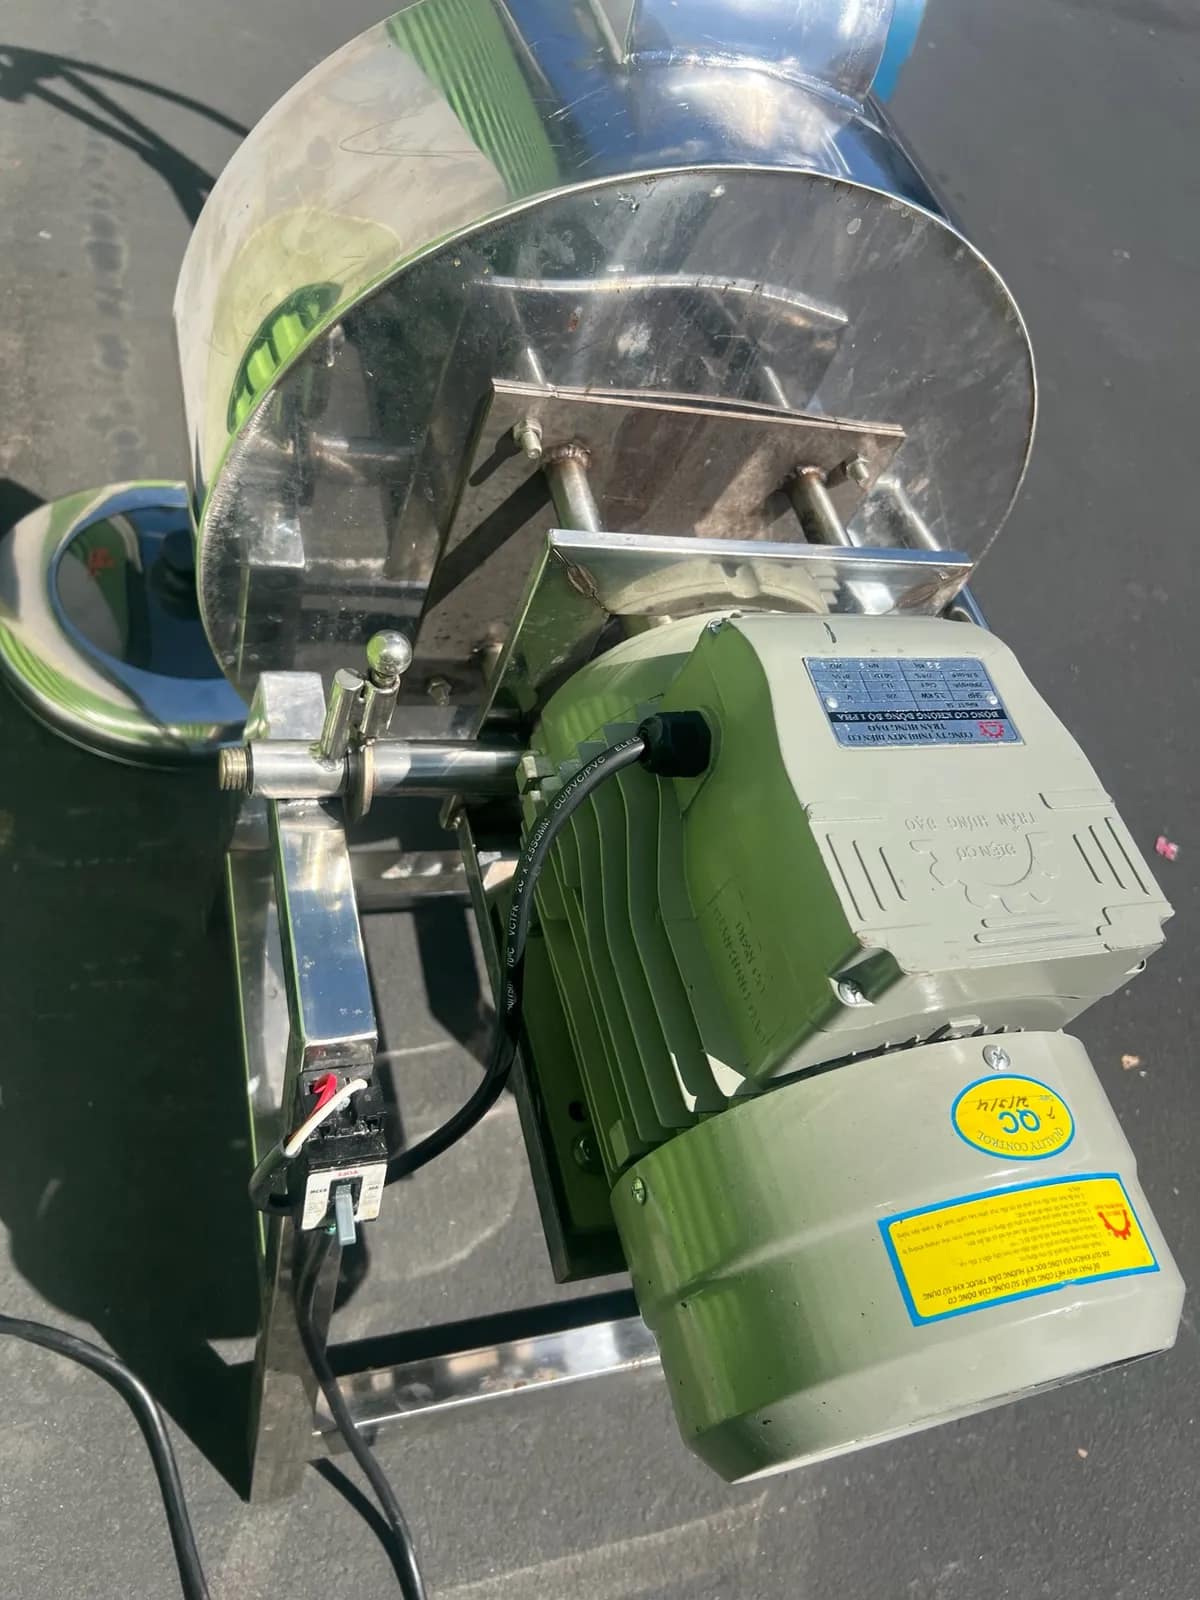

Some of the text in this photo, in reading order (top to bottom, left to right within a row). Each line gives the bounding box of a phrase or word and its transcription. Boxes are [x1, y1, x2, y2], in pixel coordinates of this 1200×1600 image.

[916, 711, 952, 720] KHÔNG
[553, 756, 606, 810] CU/PVC/PVC
[998, 1108, 1040, 1134] QC
[976, 1127, 1064, 1152] QUALITY CONTROL
[953, 1283, 964, 1292] KHI
